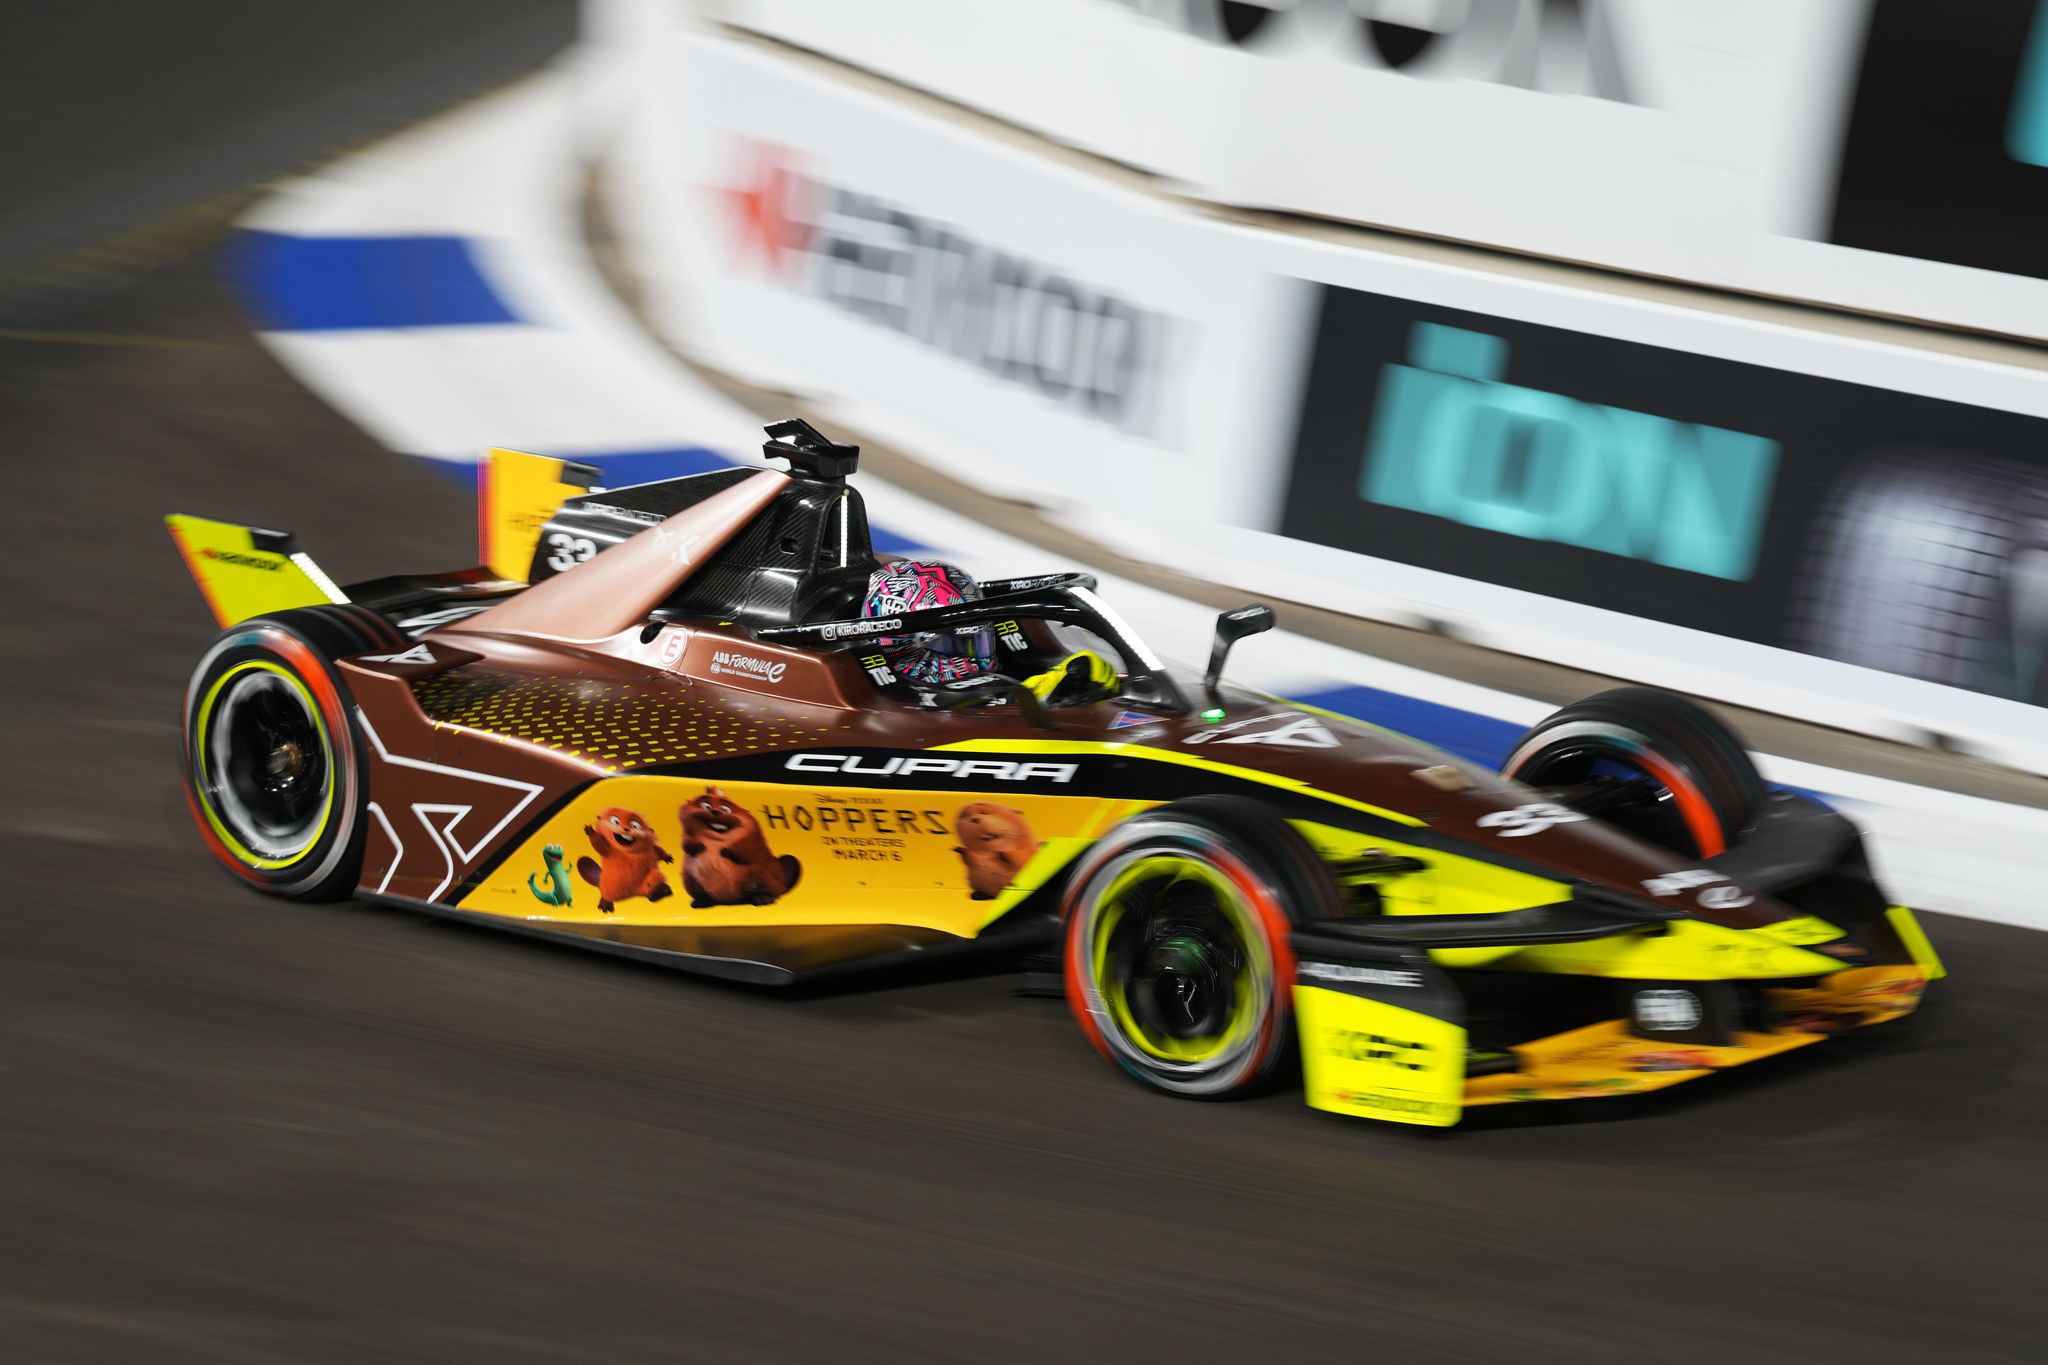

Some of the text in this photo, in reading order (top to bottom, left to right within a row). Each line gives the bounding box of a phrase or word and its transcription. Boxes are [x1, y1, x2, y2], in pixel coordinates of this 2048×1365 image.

[995, 620, 1019, 635] 33
[664, 636, 681, 657] E
[1001, 632, 1028, 652] TIC
[712, 651, 730, 664] ABB
[728, 654, 773, 674] FORMULA
[868, 666, 897, 686] TIC
[784, 753, 1079, 783] CUPRA
[760, 804, 950, 835] HOPPERS
[821, 836, 906, 848] IN THEATERS
[831, 849, 889, 862] MARCH
